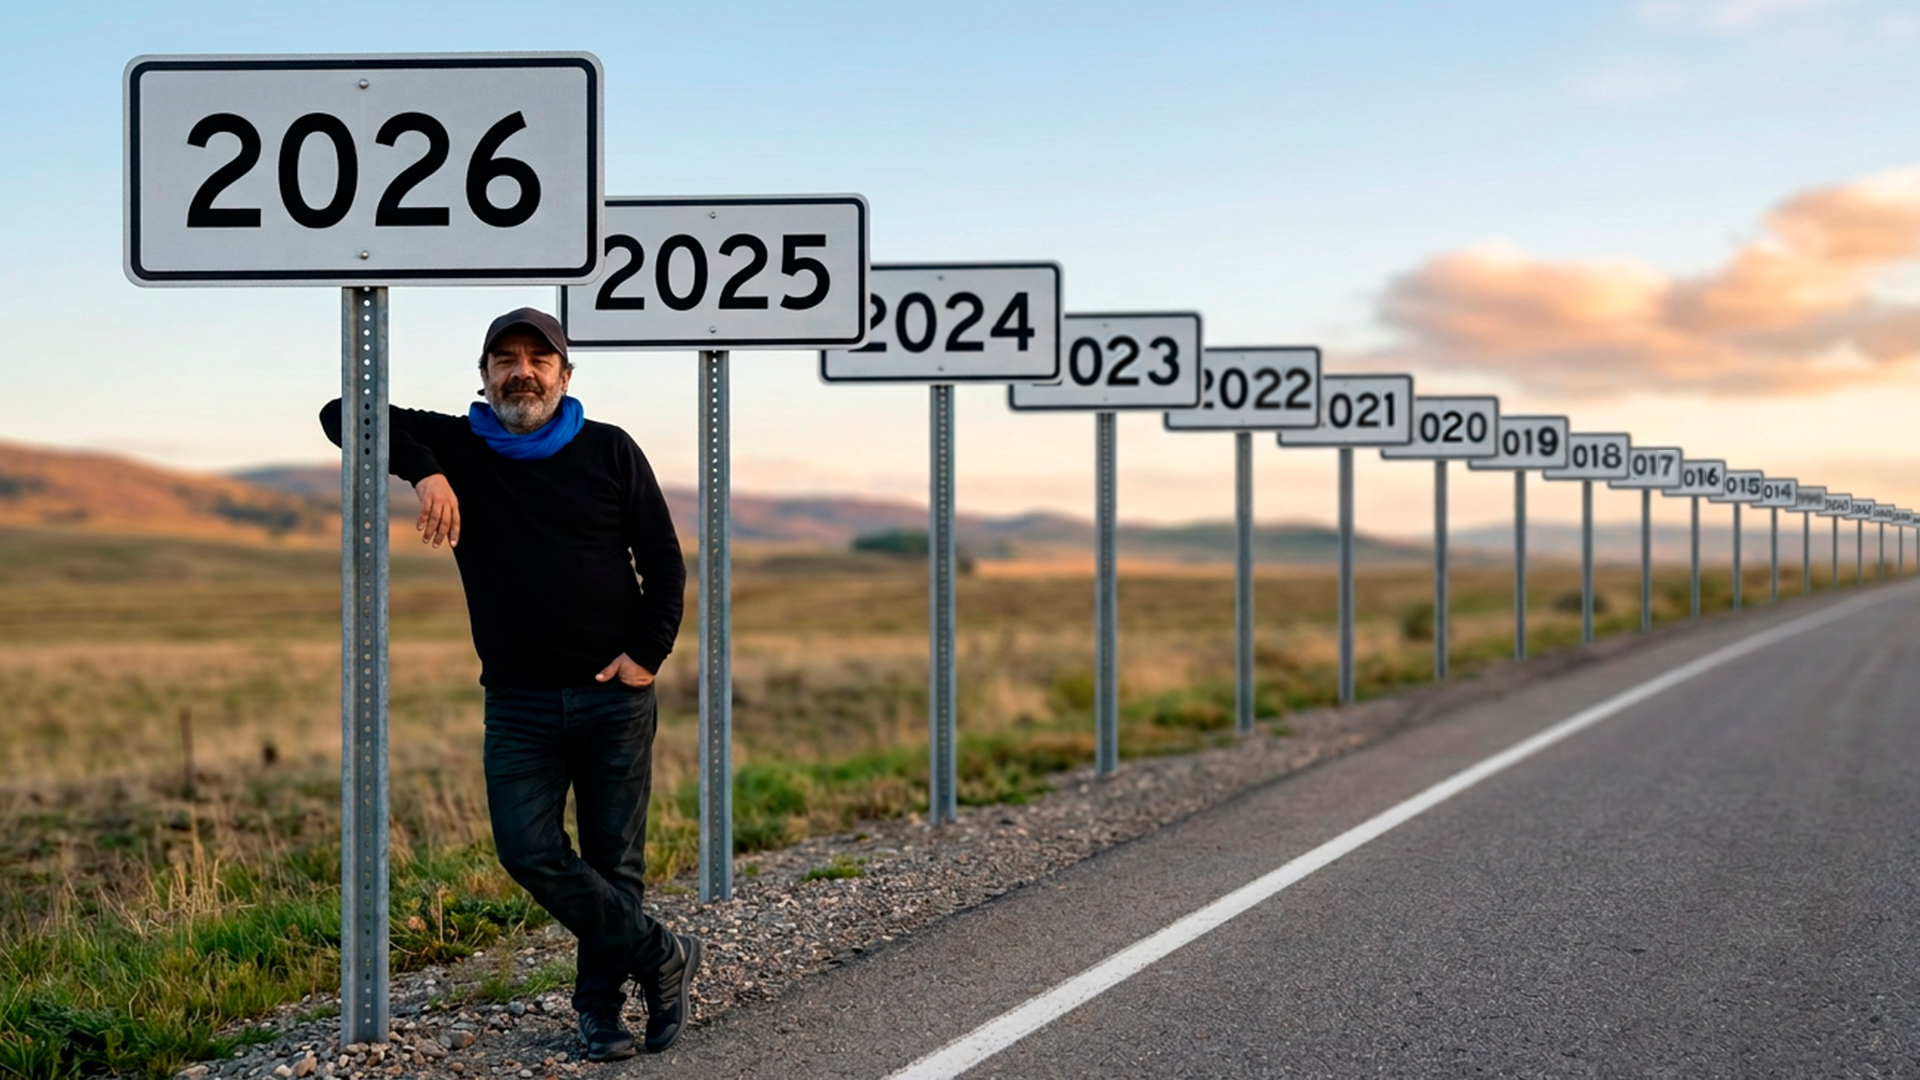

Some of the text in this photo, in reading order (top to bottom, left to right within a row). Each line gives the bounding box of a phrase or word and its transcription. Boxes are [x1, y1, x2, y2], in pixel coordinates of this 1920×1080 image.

[186, 111, 541, 229] 2026
[595, 233, 831, 311] 2025
[1034, 335, 1180, 386] 023
[1321, 391, 1395, 430] 021
[1419, 410, 1488, 444] 020
[1502, 426, 1560, 457] 019
[1571, 442, 1623, 469] 018
[1632, 453, 1675, 476] 017
[1682, 467, 1721, 488] 016
[1726, 477, 1761, 496] 015
